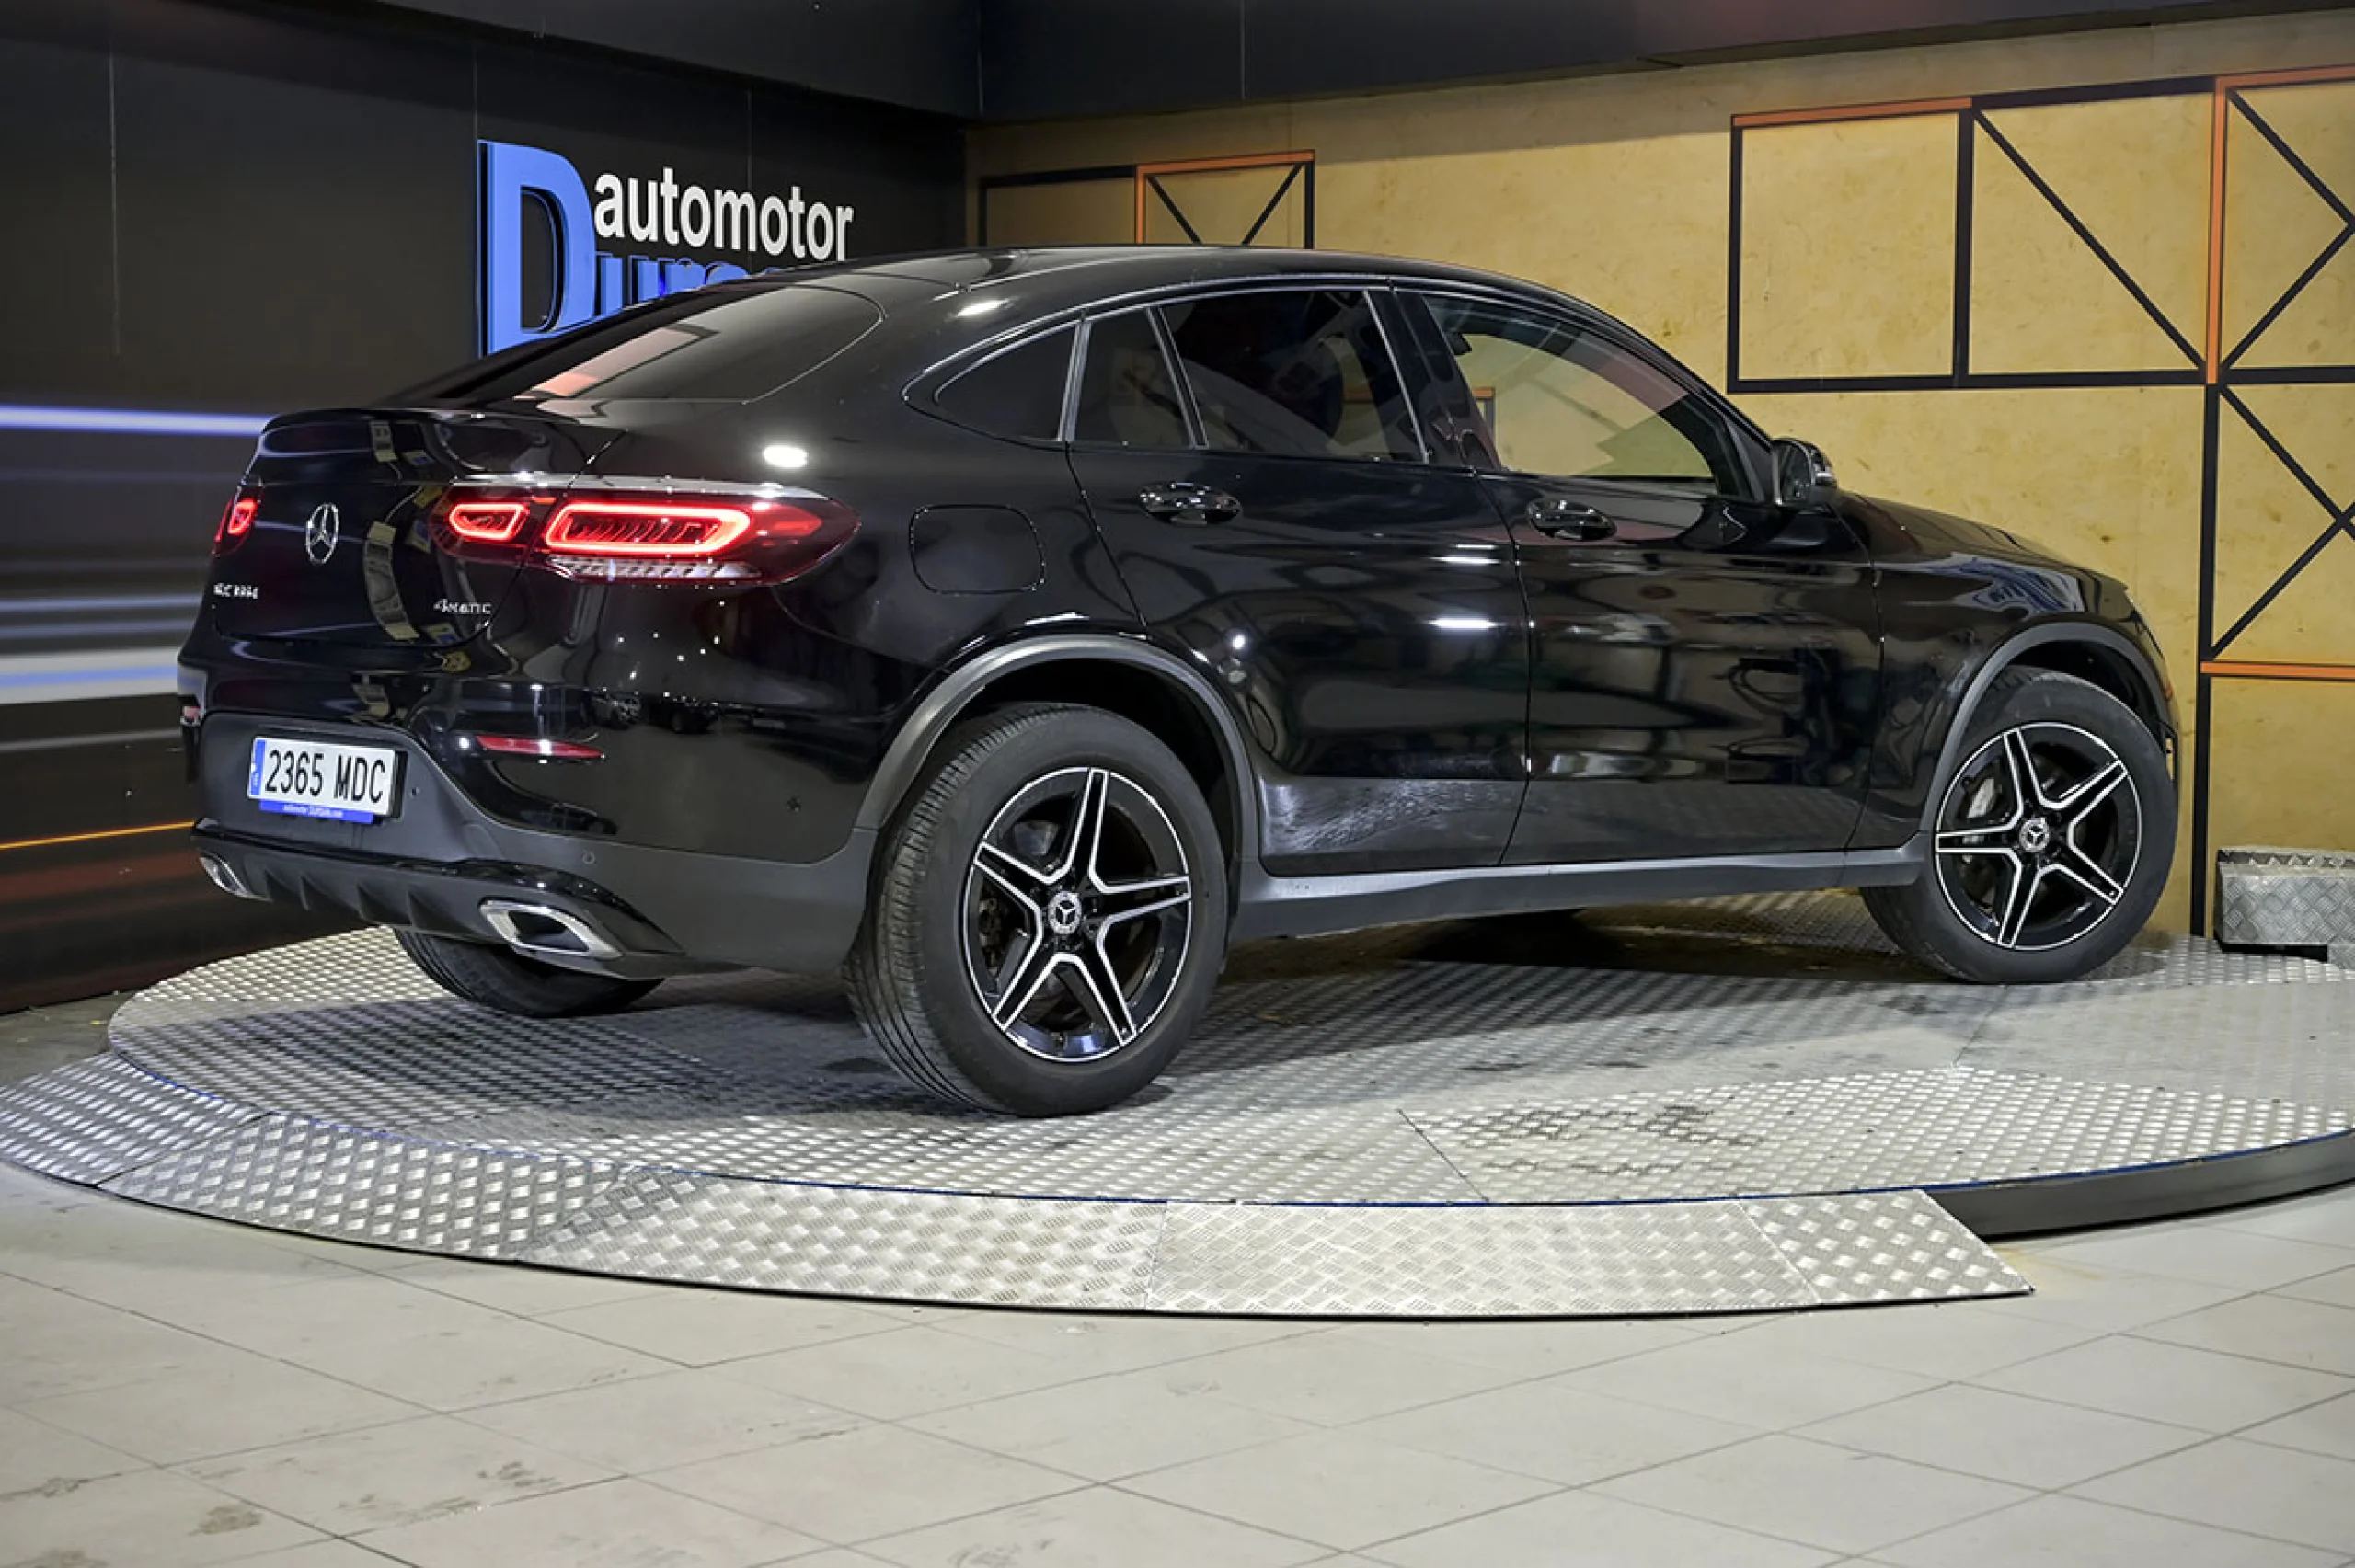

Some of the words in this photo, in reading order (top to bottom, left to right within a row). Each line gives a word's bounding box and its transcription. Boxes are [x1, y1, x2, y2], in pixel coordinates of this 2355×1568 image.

[594, 167, 854, 261] automotor
[265, 749, 324, 796] 2365
[334, 754, 385, 803] MDC
